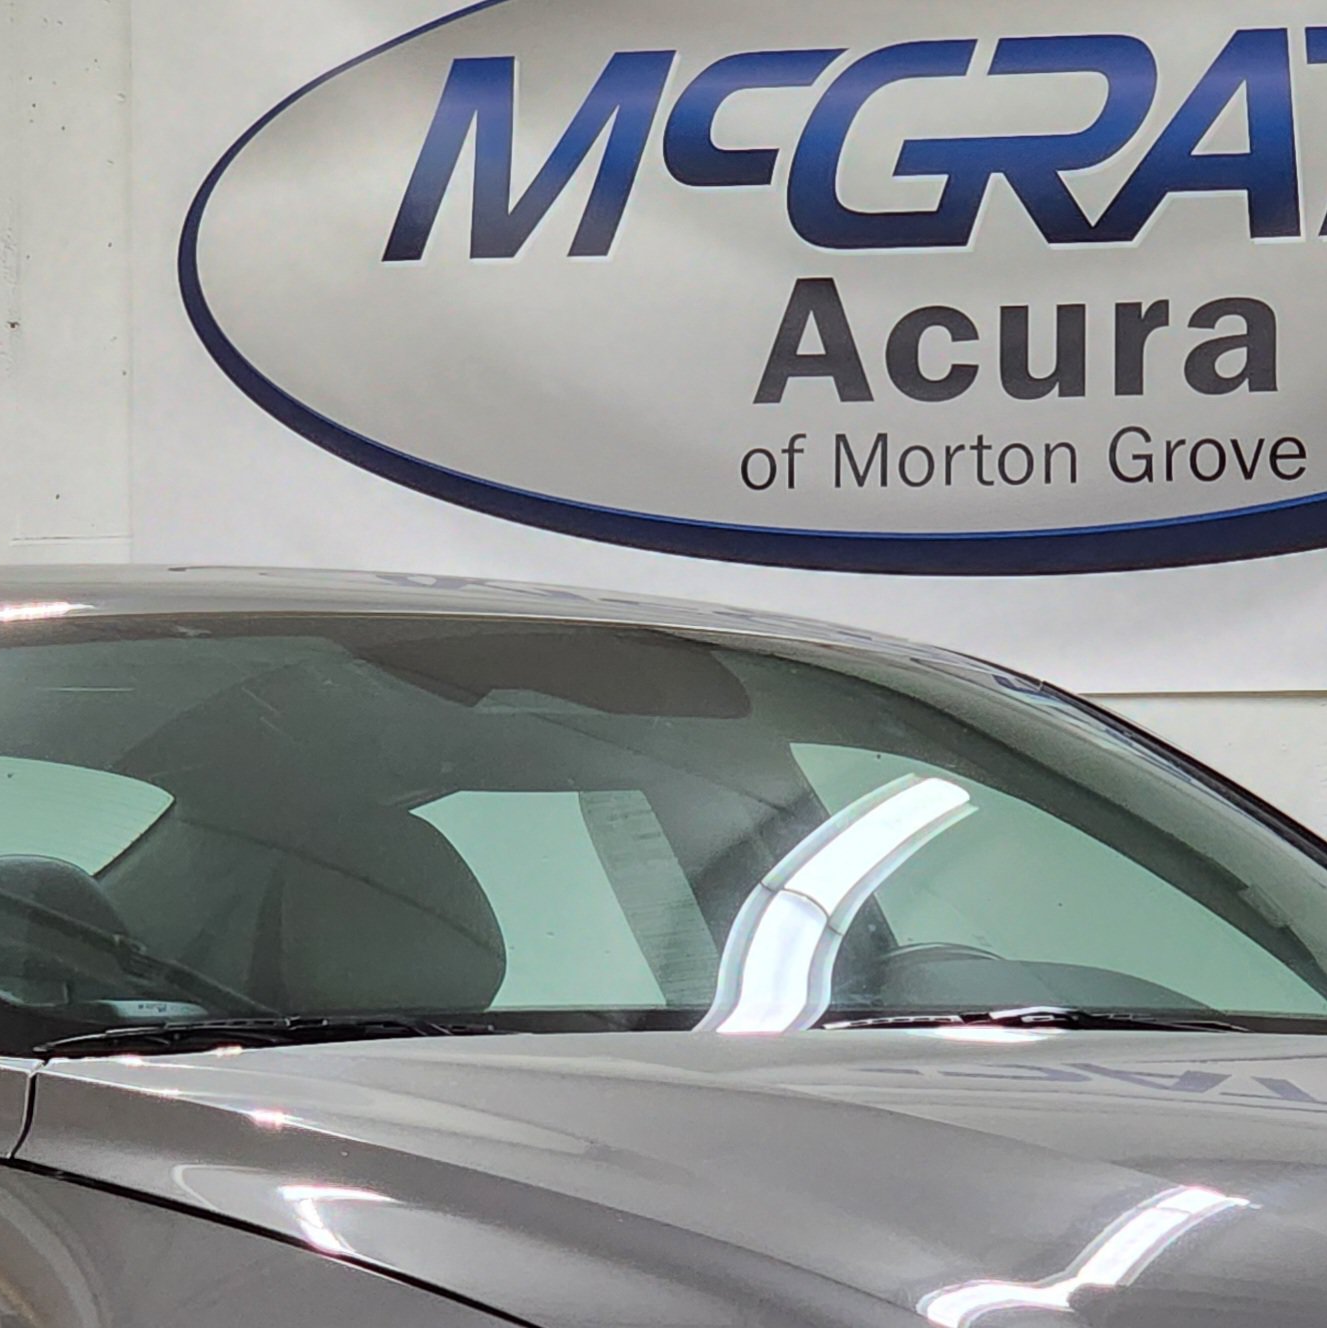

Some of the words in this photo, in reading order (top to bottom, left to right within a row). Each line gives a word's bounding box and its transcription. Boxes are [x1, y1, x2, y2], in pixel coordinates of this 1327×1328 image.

[752, 277, 1279, 405] Acura
[739, 432, 808, 491] of
[833, 432, 1078, 490] Morton
[1107, 425, 1309, 487] Grove
